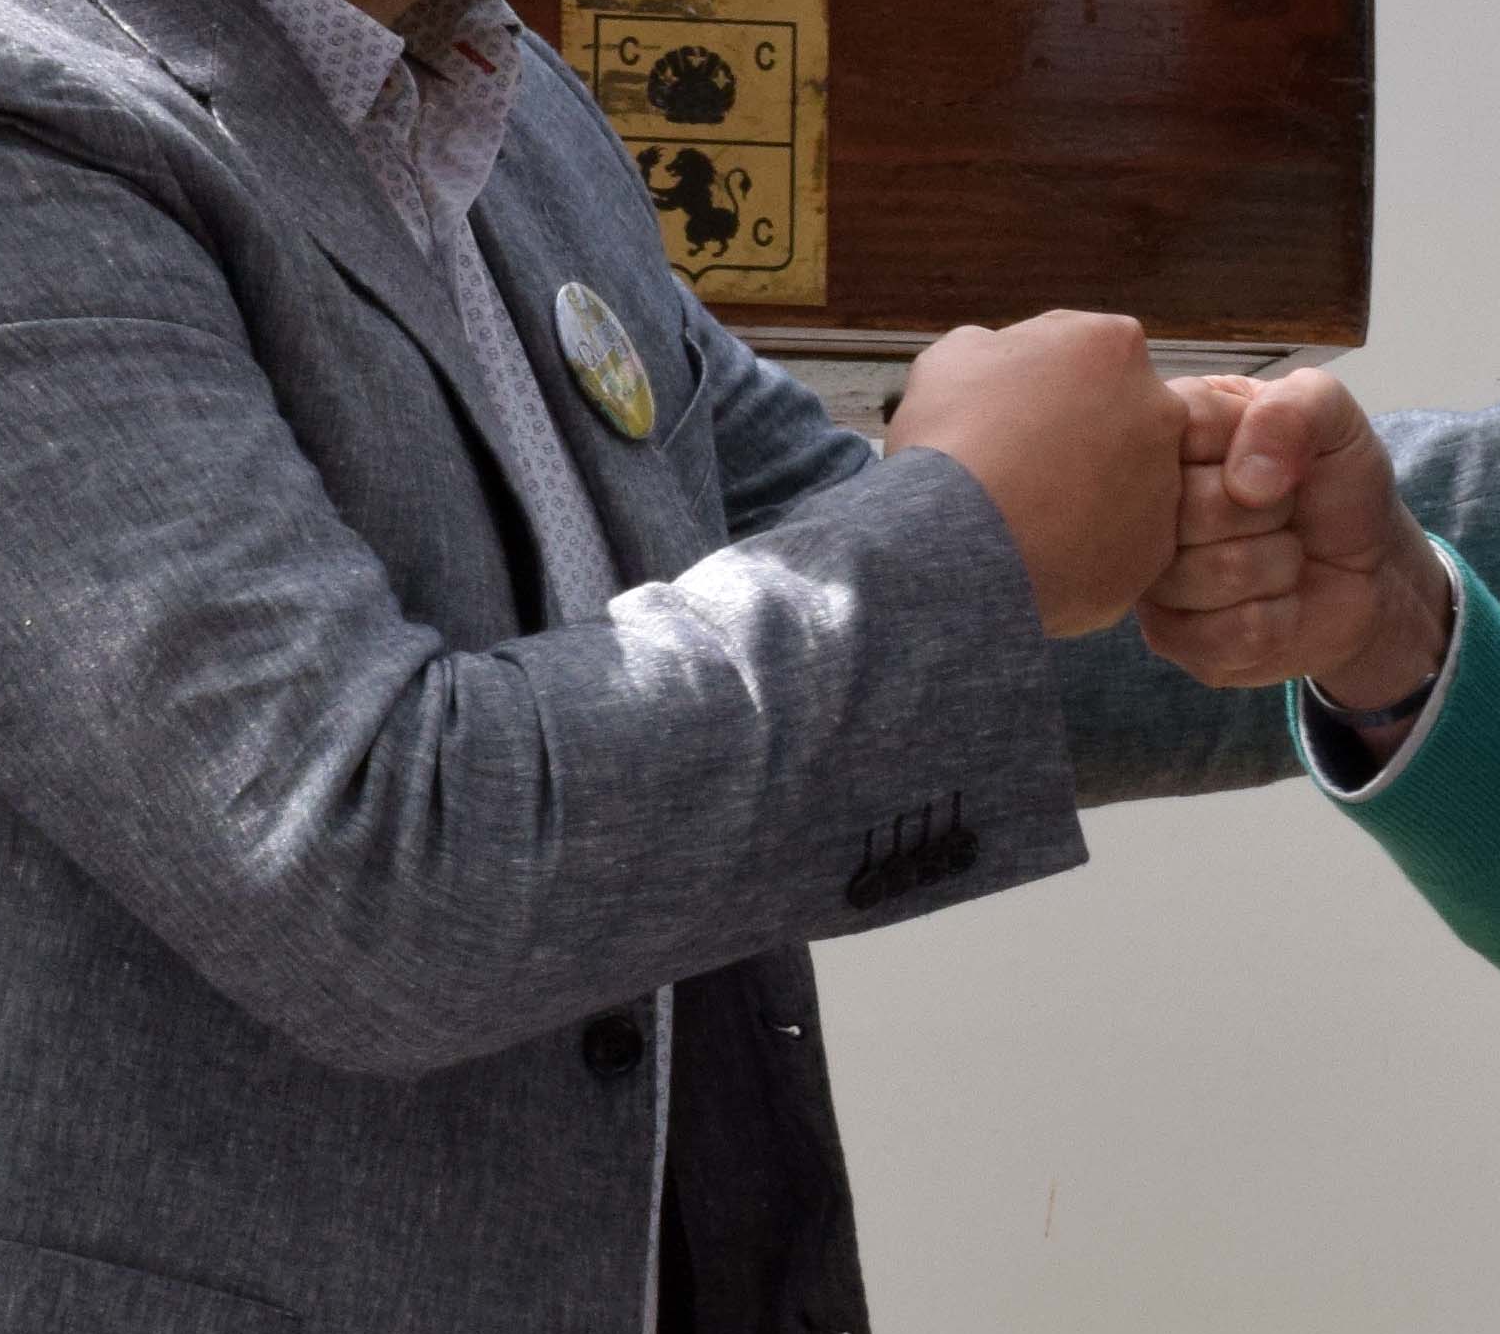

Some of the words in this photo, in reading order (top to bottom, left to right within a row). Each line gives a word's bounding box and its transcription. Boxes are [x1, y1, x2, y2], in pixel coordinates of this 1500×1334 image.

[619, 36, 641, 66] C
[755, 41, 776, 71] C
[753, 217, 775, 247] C
